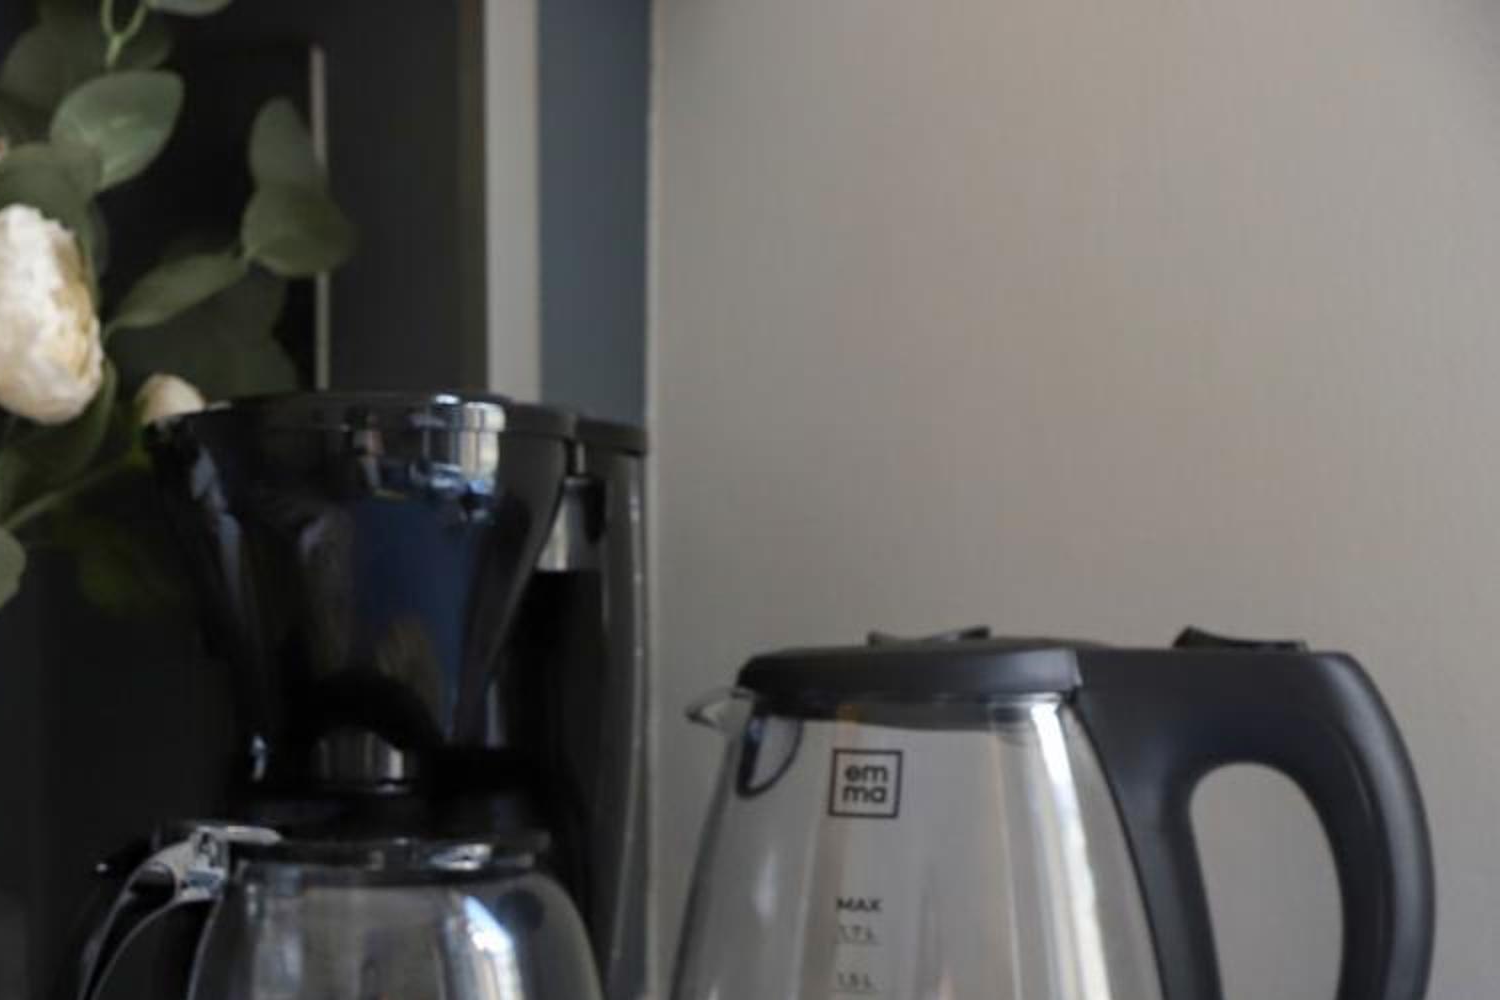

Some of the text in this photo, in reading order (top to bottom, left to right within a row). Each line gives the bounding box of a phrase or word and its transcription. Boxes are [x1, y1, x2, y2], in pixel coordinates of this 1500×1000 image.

[845, 765, 889, 782] em
[843, 786, 887, 804] ma
[837, 898, 883, 912] MAX
